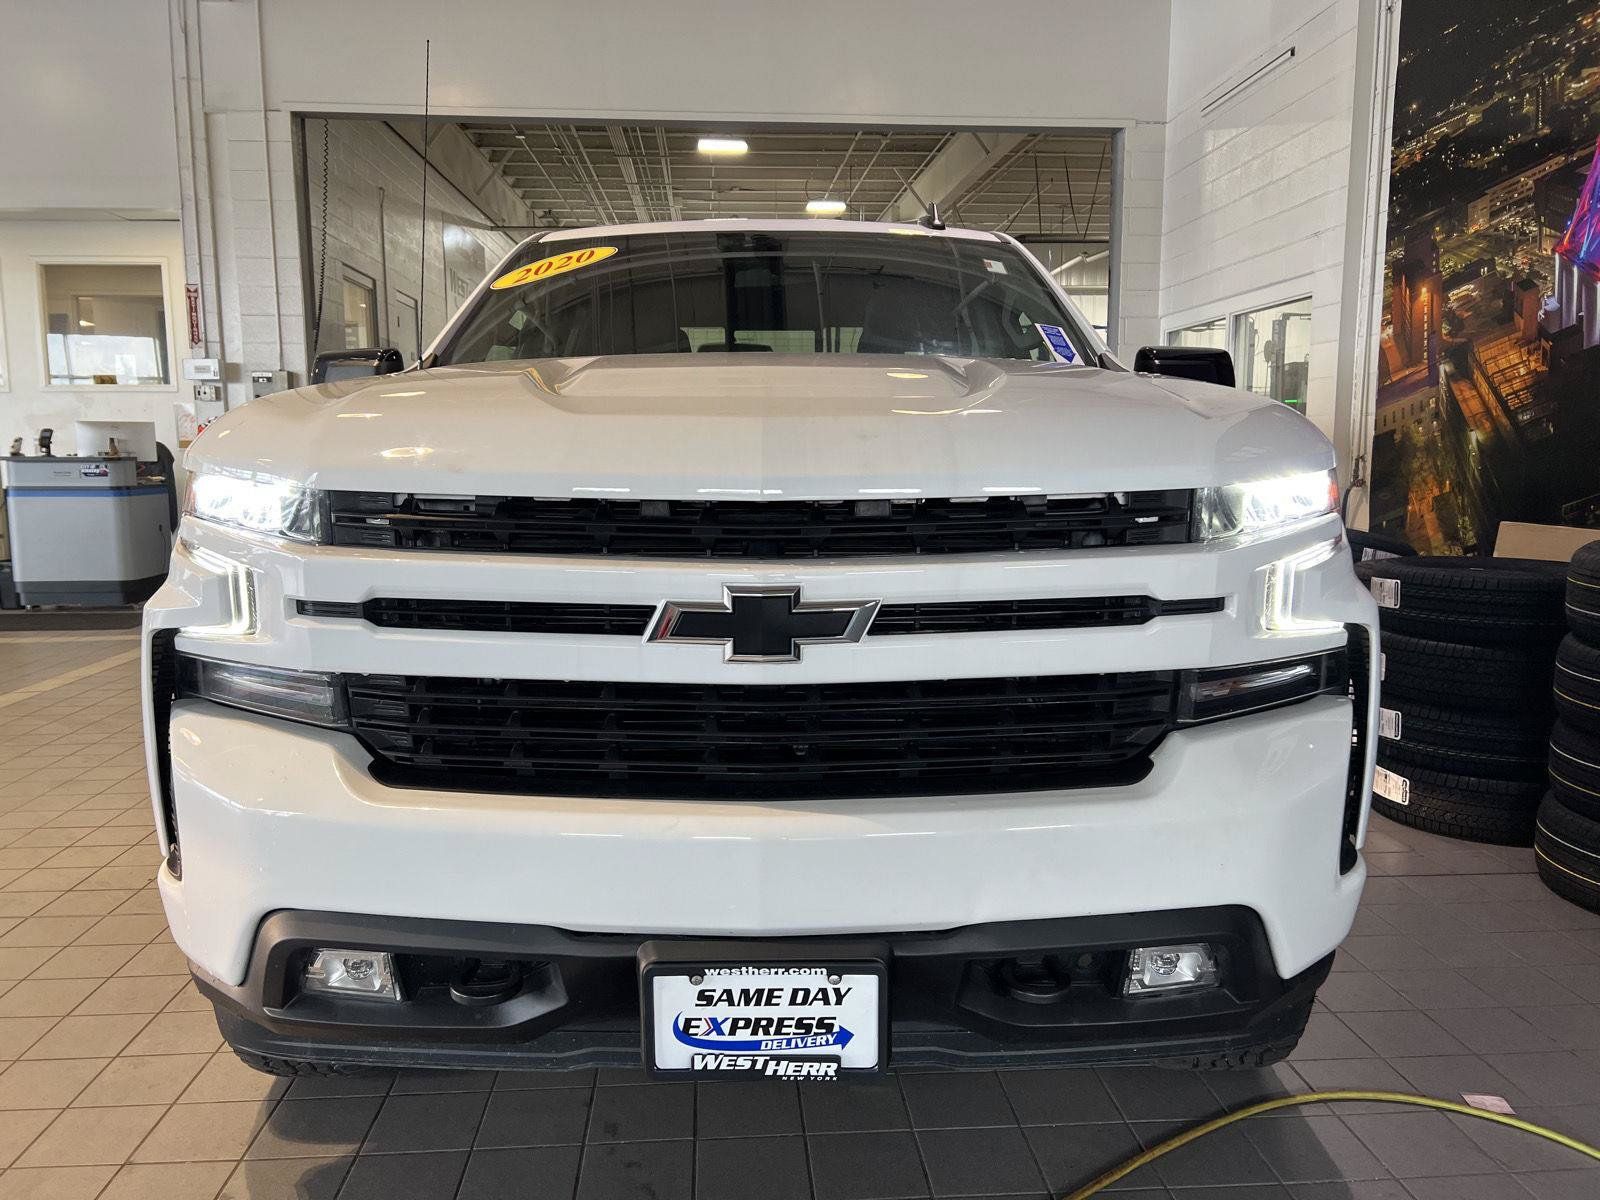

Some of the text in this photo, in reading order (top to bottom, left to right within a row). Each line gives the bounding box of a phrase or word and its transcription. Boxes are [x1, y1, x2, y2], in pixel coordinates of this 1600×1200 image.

[513, 250, 595, 284] 2020
[704, 967, 828, 977] westherr.com
[694, 987, 852, 1007] SAME DAY
[681, 1016, 837, 1036] EXPRESS
[760, 1035, 837, 1051] DELIVERY
